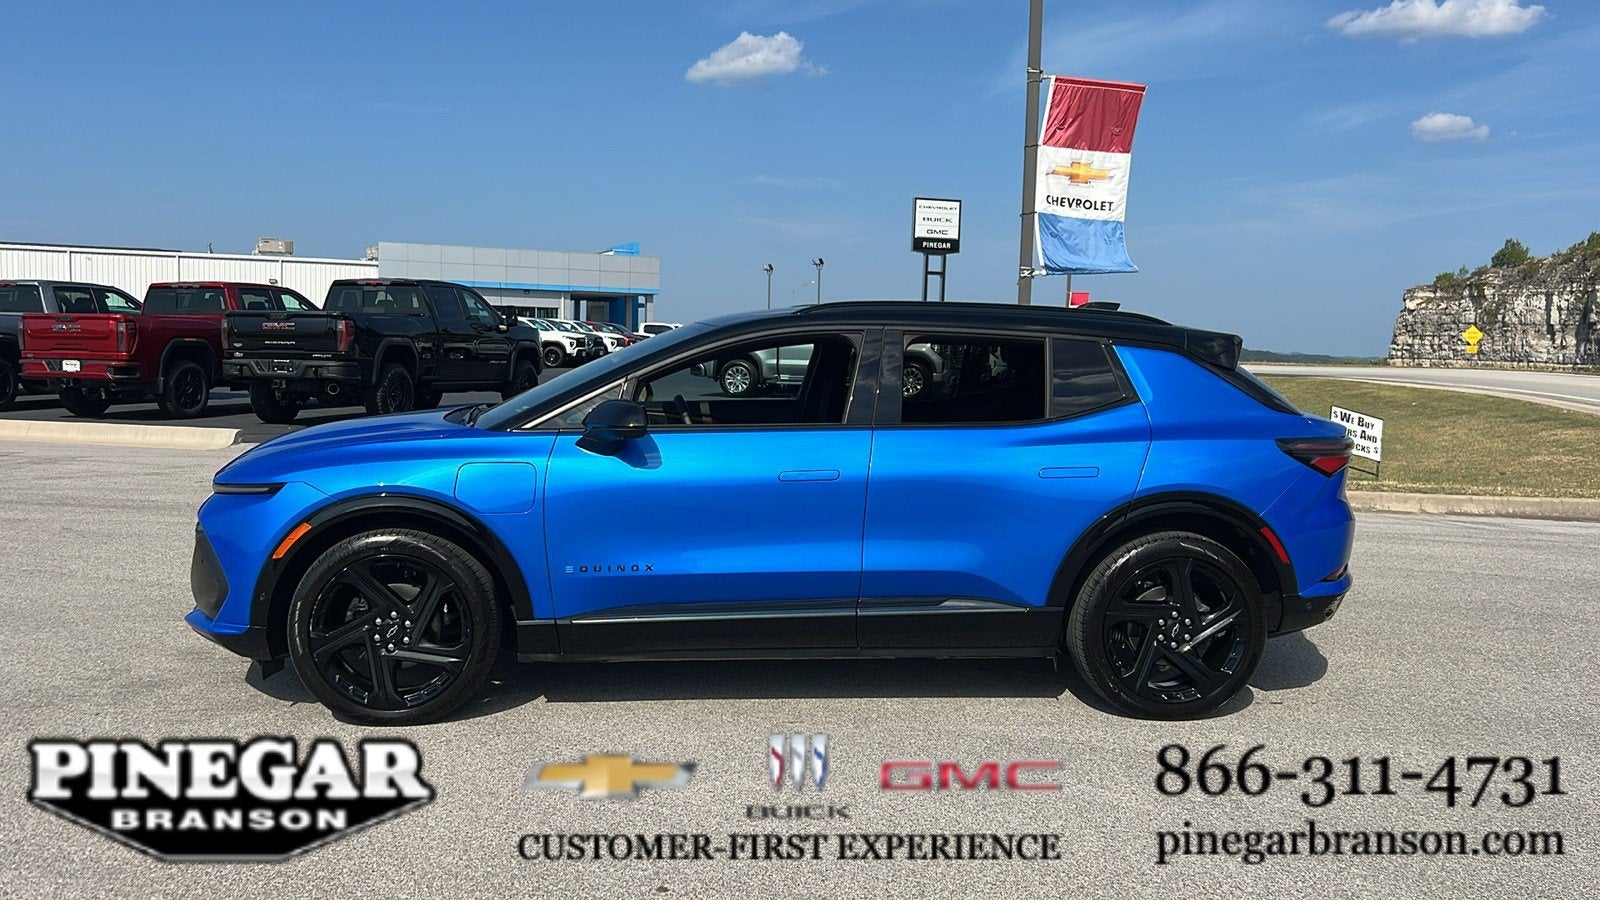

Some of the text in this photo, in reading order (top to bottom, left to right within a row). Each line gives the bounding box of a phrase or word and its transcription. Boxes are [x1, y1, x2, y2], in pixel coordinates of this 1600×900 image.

[1046, 194, 1114, 211] CHEVROLET
[922, 241, 951, 249] PINEGAR
[1357, 417, 1374, 429] BUY
[1347, 429, 1377, 443] RS AND
[1355, 443, 1370, 453] CKS
[565, 564, 655, 573] EQUINOX
